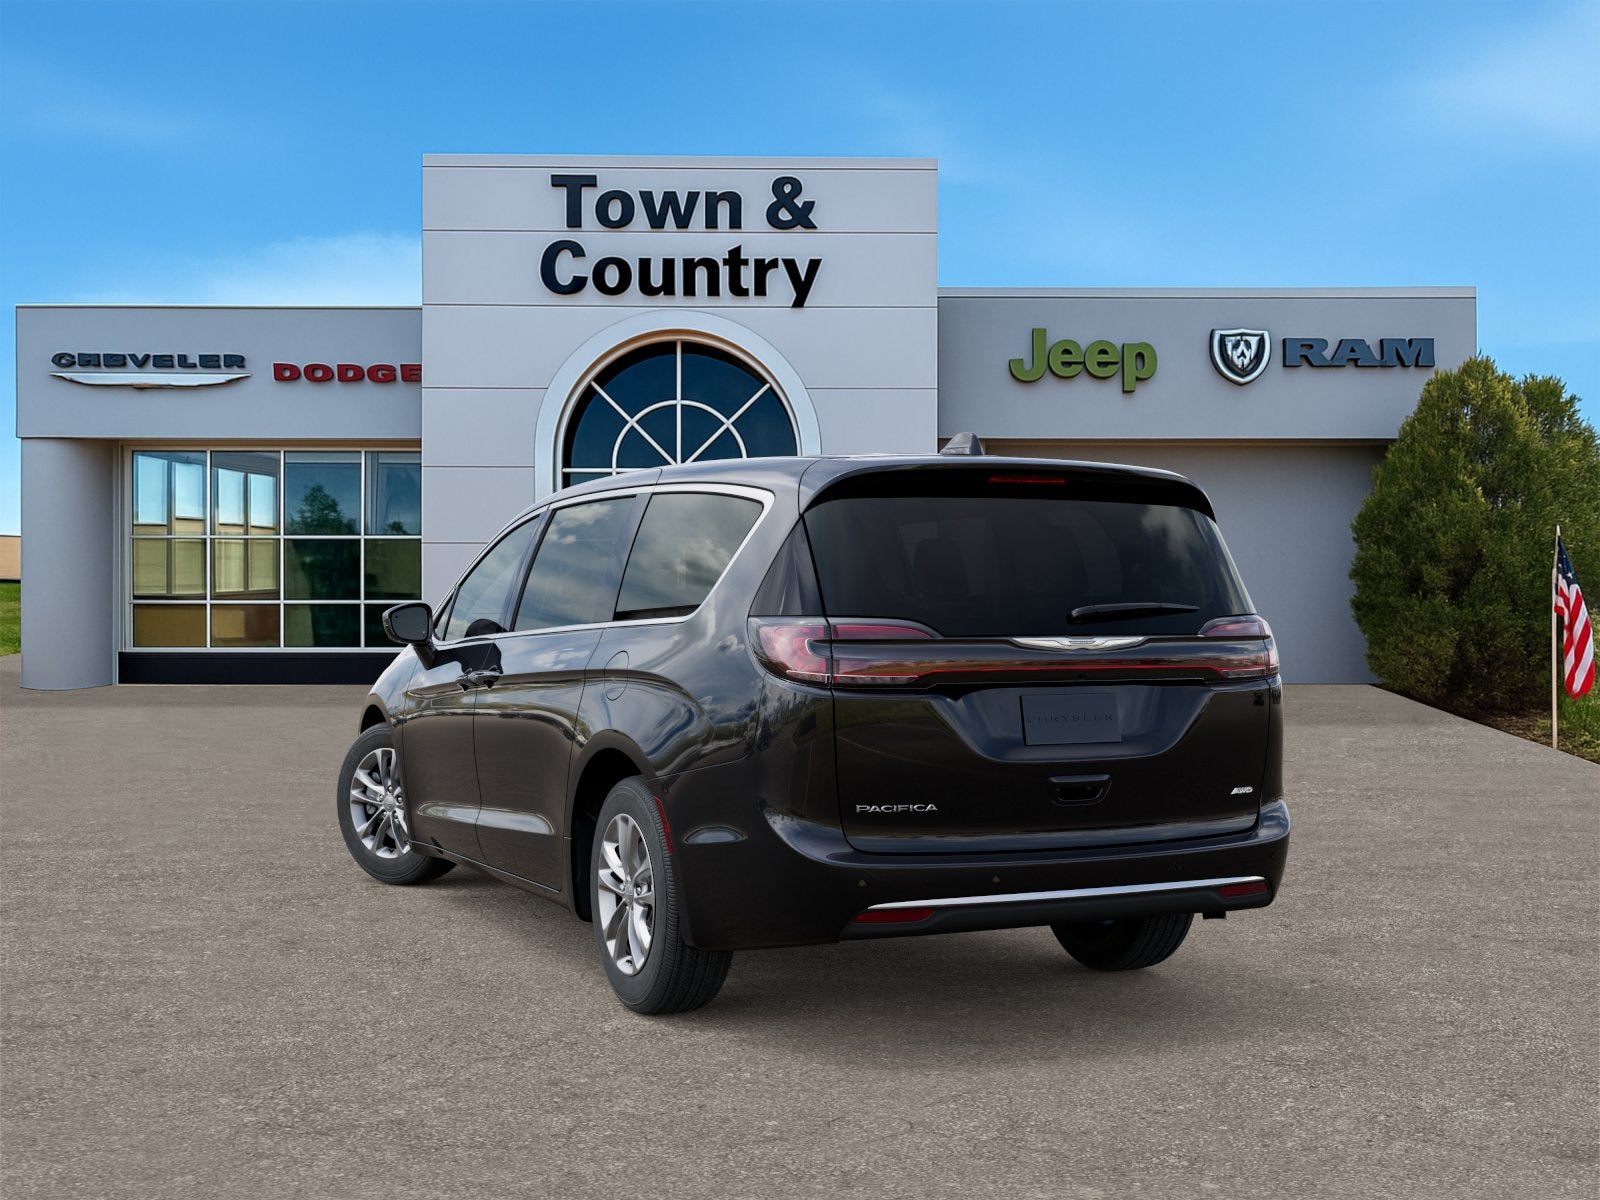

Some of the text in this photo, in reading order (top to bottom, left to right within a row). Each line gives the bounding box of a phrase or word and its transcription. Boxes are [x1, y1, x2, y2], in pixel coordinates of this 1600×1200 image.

[550, 174, 818, 230] Town &
[540, 239, 822, 308] Country
[1008, 327, 1157, 392] Jeep
[1282, 337, 1436, 368] RAM
[273, 362, 422, 383] DODGE
[1230, 786, 1254, 795] AWD
[855, 803, 938, 813] PACIFICA
